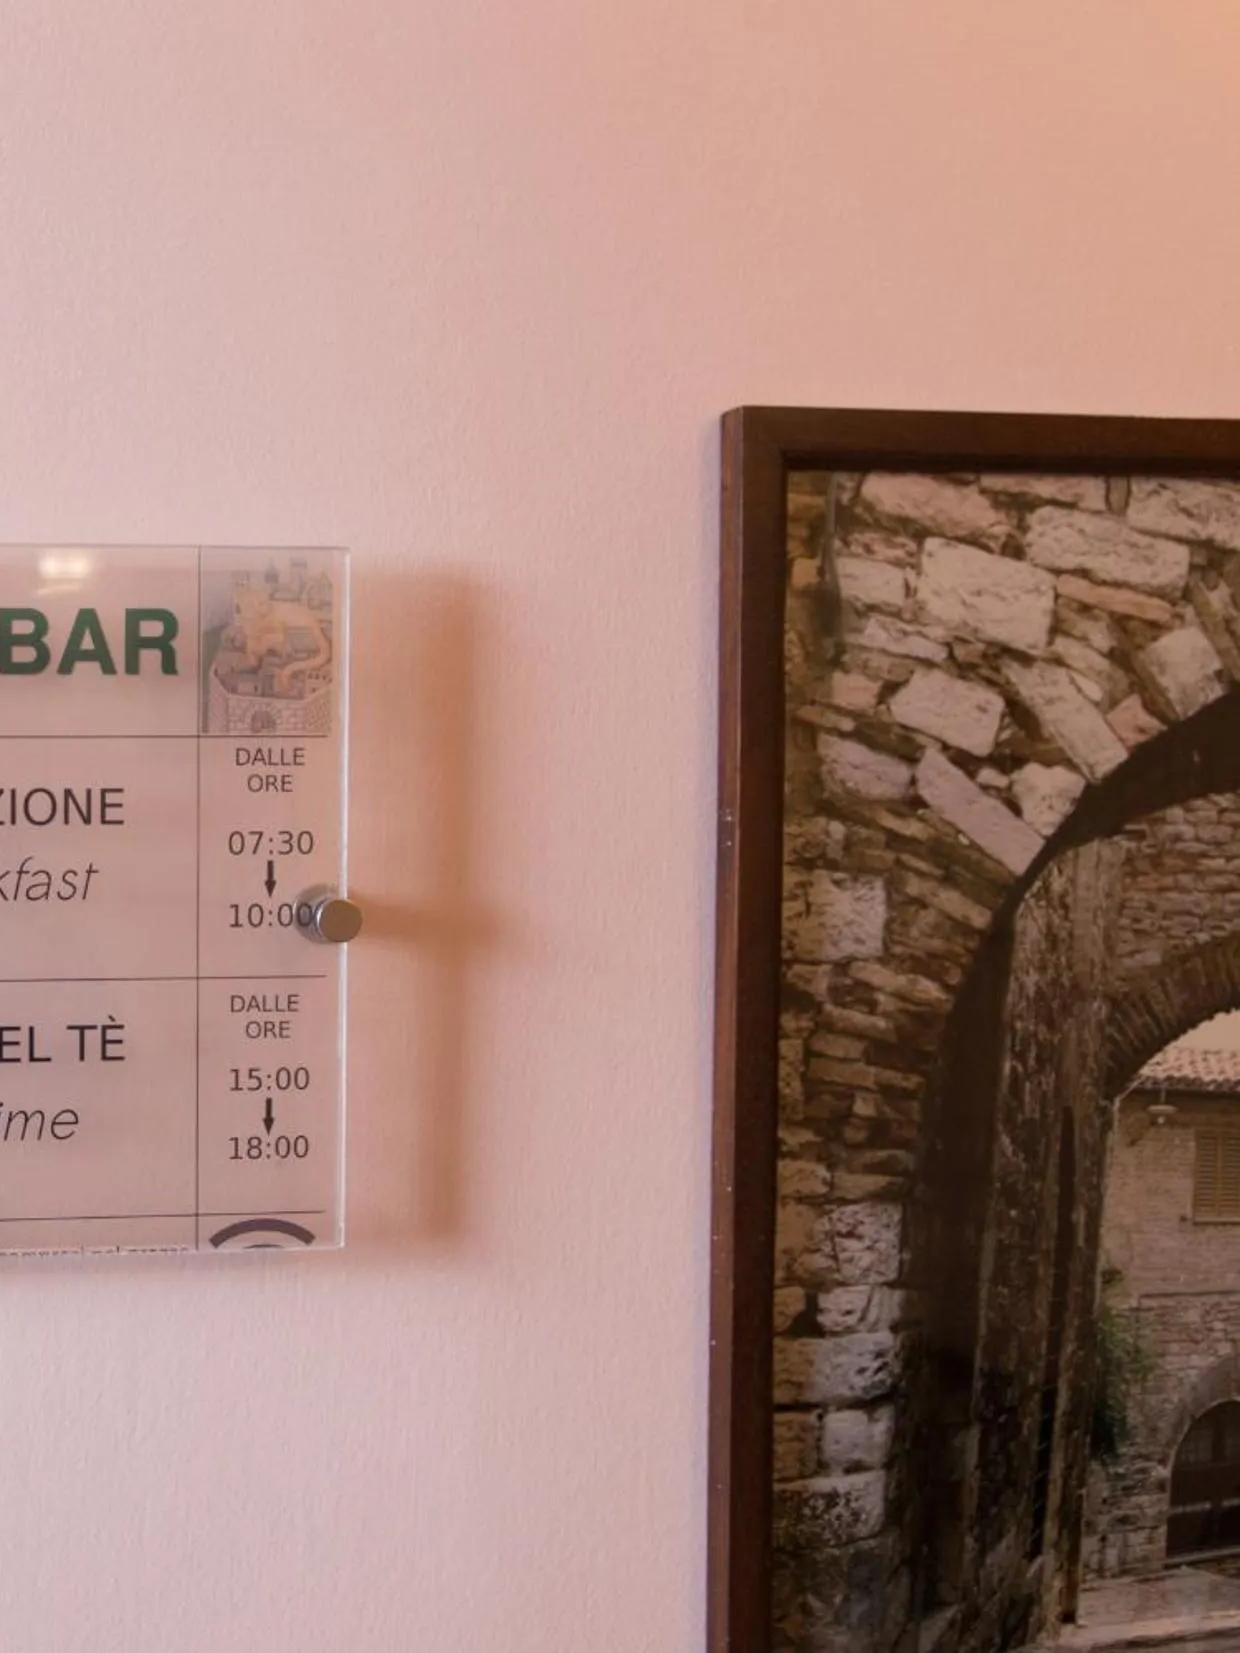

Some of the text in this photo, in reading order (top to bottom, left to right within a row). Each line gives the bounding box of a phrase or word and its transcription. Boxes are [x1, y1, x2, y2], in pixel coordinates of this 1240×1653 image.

[235, 748, 306, 767] DALLE
[247, 775, 294, 793] ORE
[228, 831, 314, 856] 07:30
[229, 904, 315, 928] 10:00
[230, 994, 299, 1013] DALLE
[67, 1015, 125, 1061] TÈ
[245, 1021, 291, 1039] ORE
[230, 1067, 310, 1092] 15:00
[229, 1136, 309, 1160] 18:00
